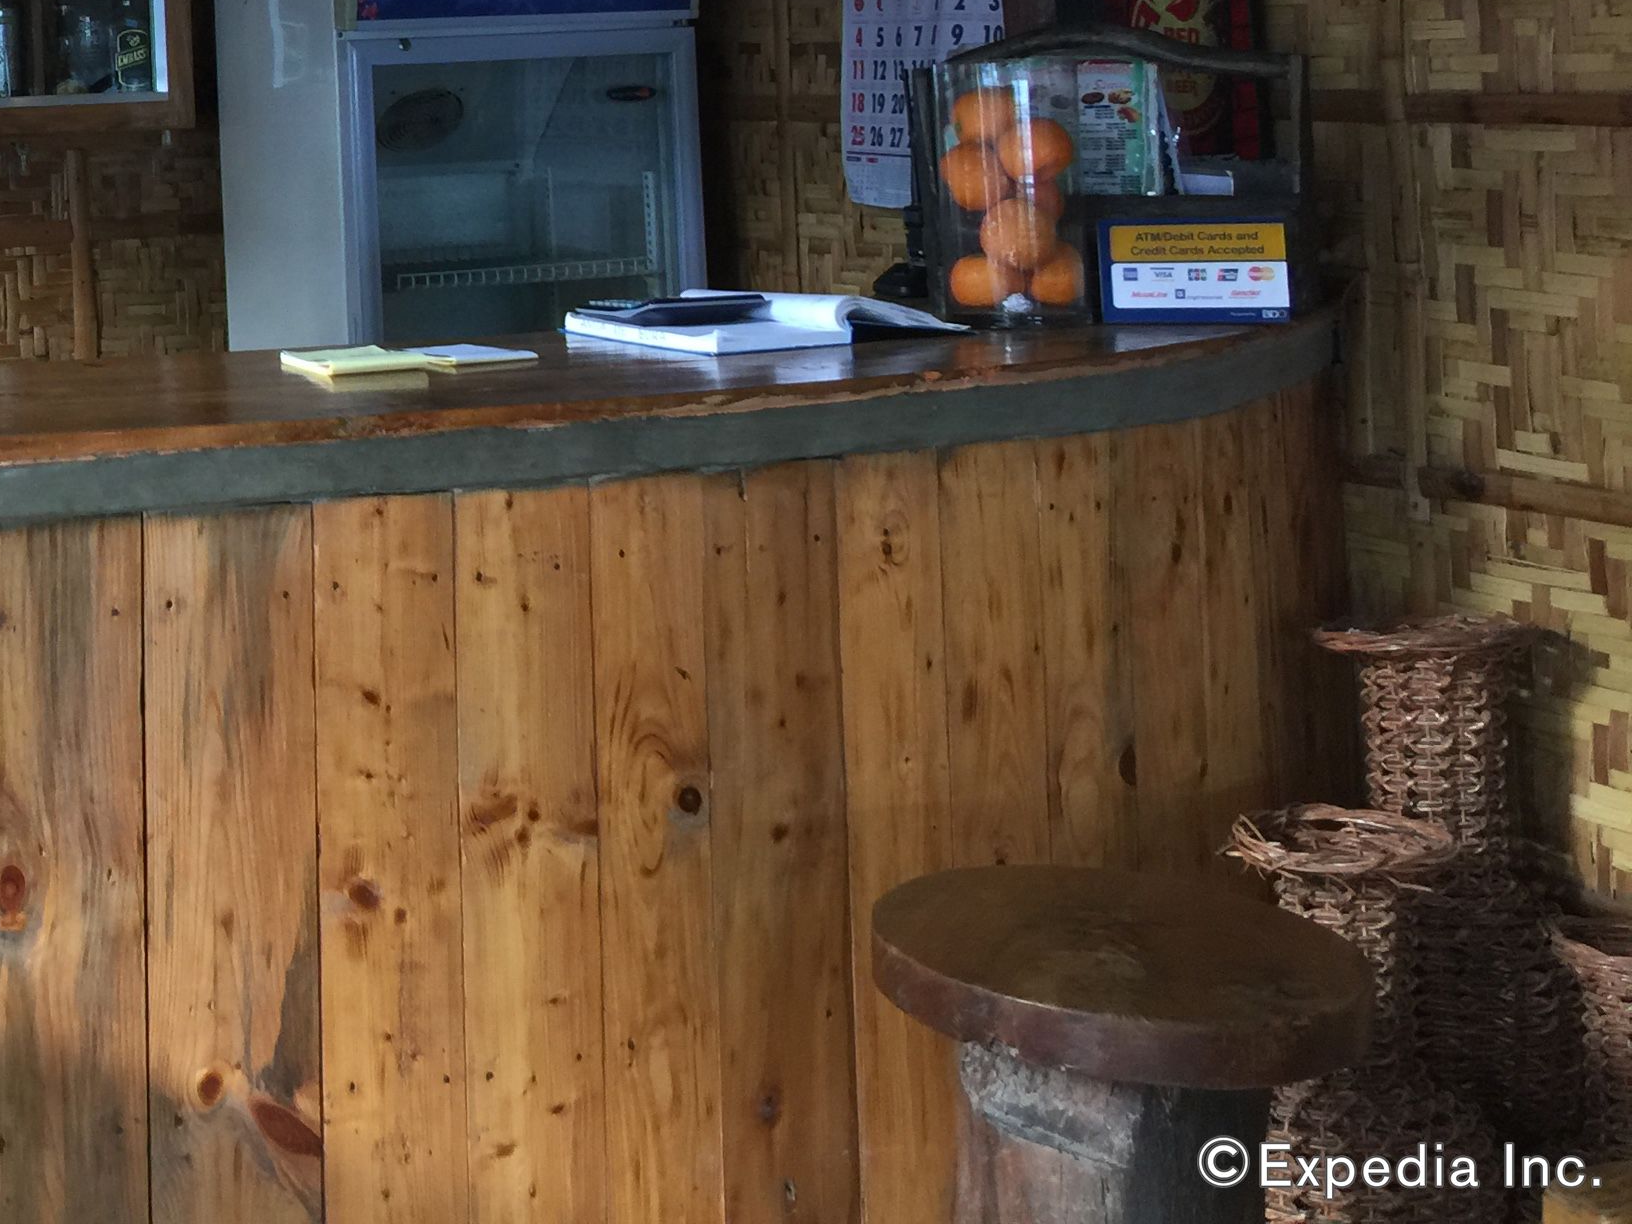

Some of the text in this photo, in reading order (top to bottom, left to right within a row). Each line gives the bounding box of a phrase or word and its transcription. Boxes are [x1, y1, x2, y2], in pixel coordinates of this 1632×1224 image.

[854, 23, 1004, 48] 4 5 6 7 9 10
[852, 60, 866, 81] 11
[872, 59, 888, 81] 12
[892, 59, 906, 81] 13
[851, 92, 905, 115] 18 19 20
[850, 124, 904, 149] 25 26 27
[1135, 230, 1259, 243] ATM/Debit Cards and
[1130, 245, 1265, 257] Credit Cards Accepted
[1153, 270, 1173, 279] VISA
